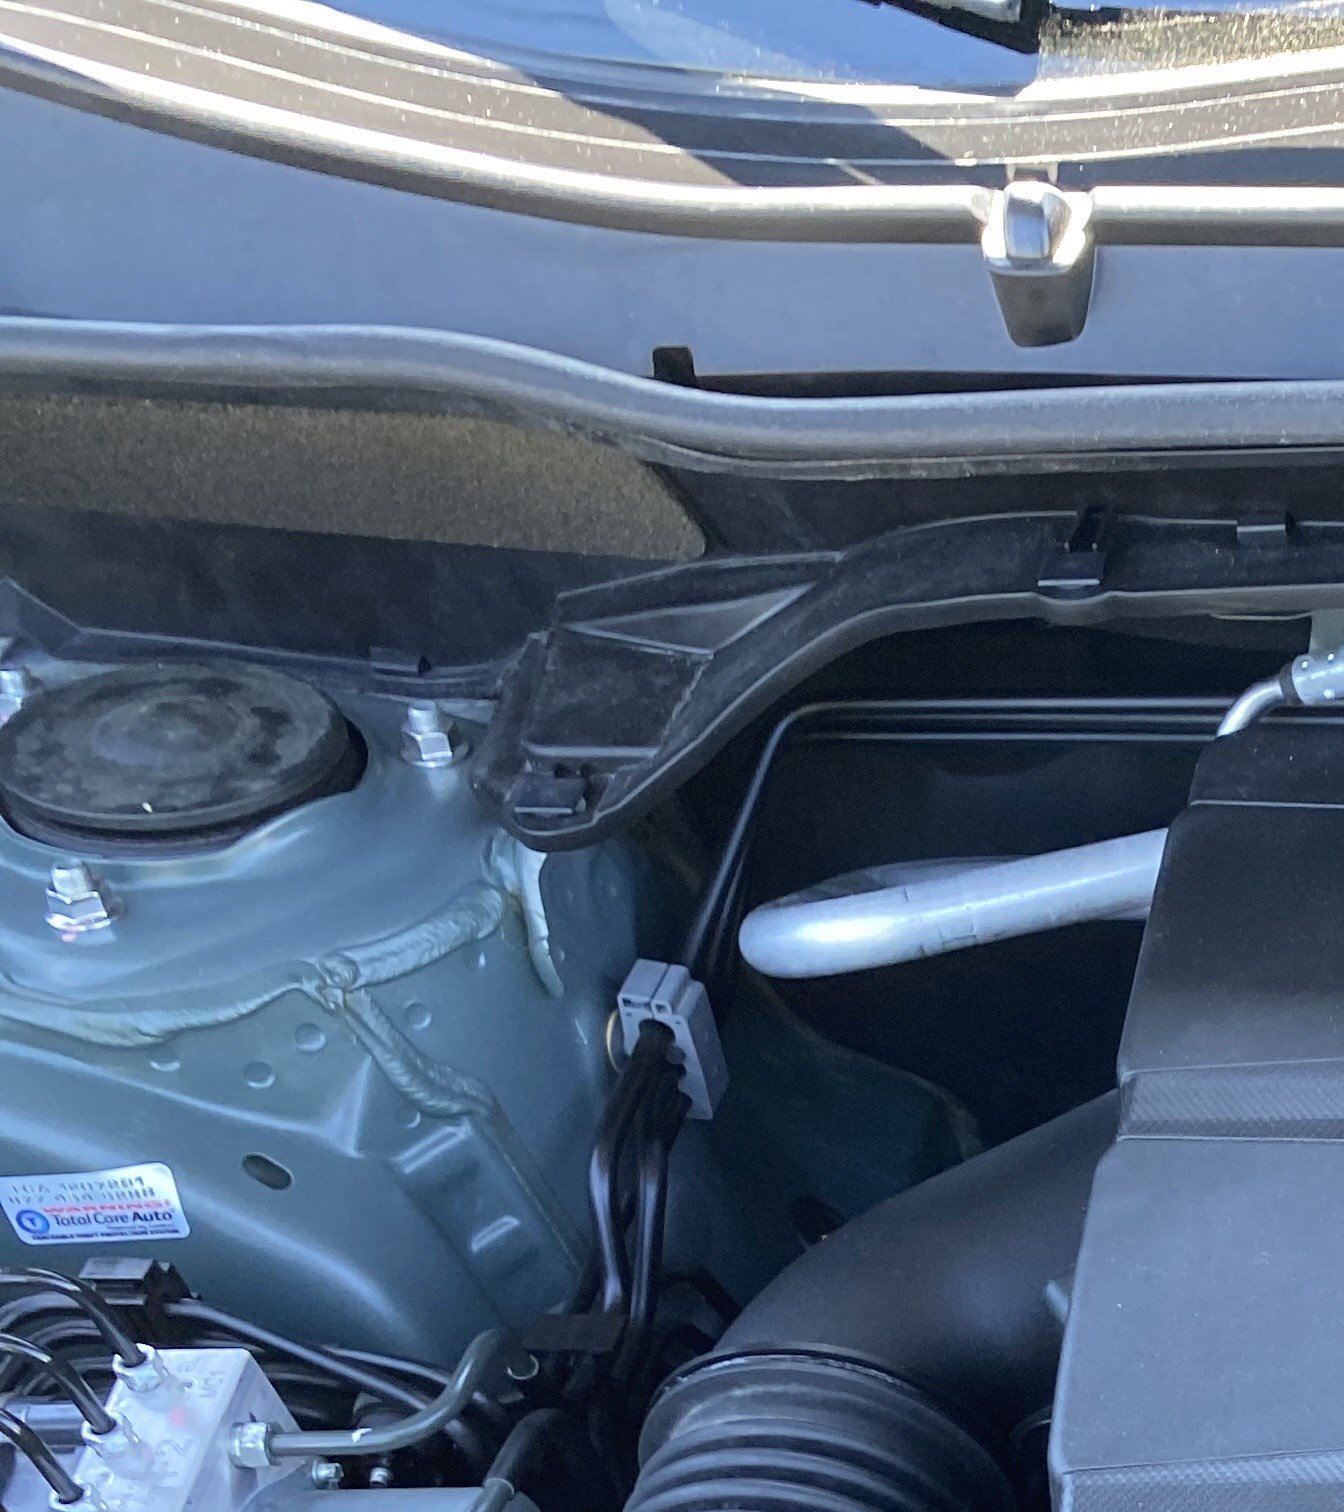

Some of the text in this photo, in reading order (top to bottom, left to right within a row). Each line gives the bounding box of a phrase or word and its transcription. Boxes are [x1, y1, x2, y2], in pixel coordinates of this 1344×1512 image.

[55, 1210, 173, 1227] Total Care Auto
